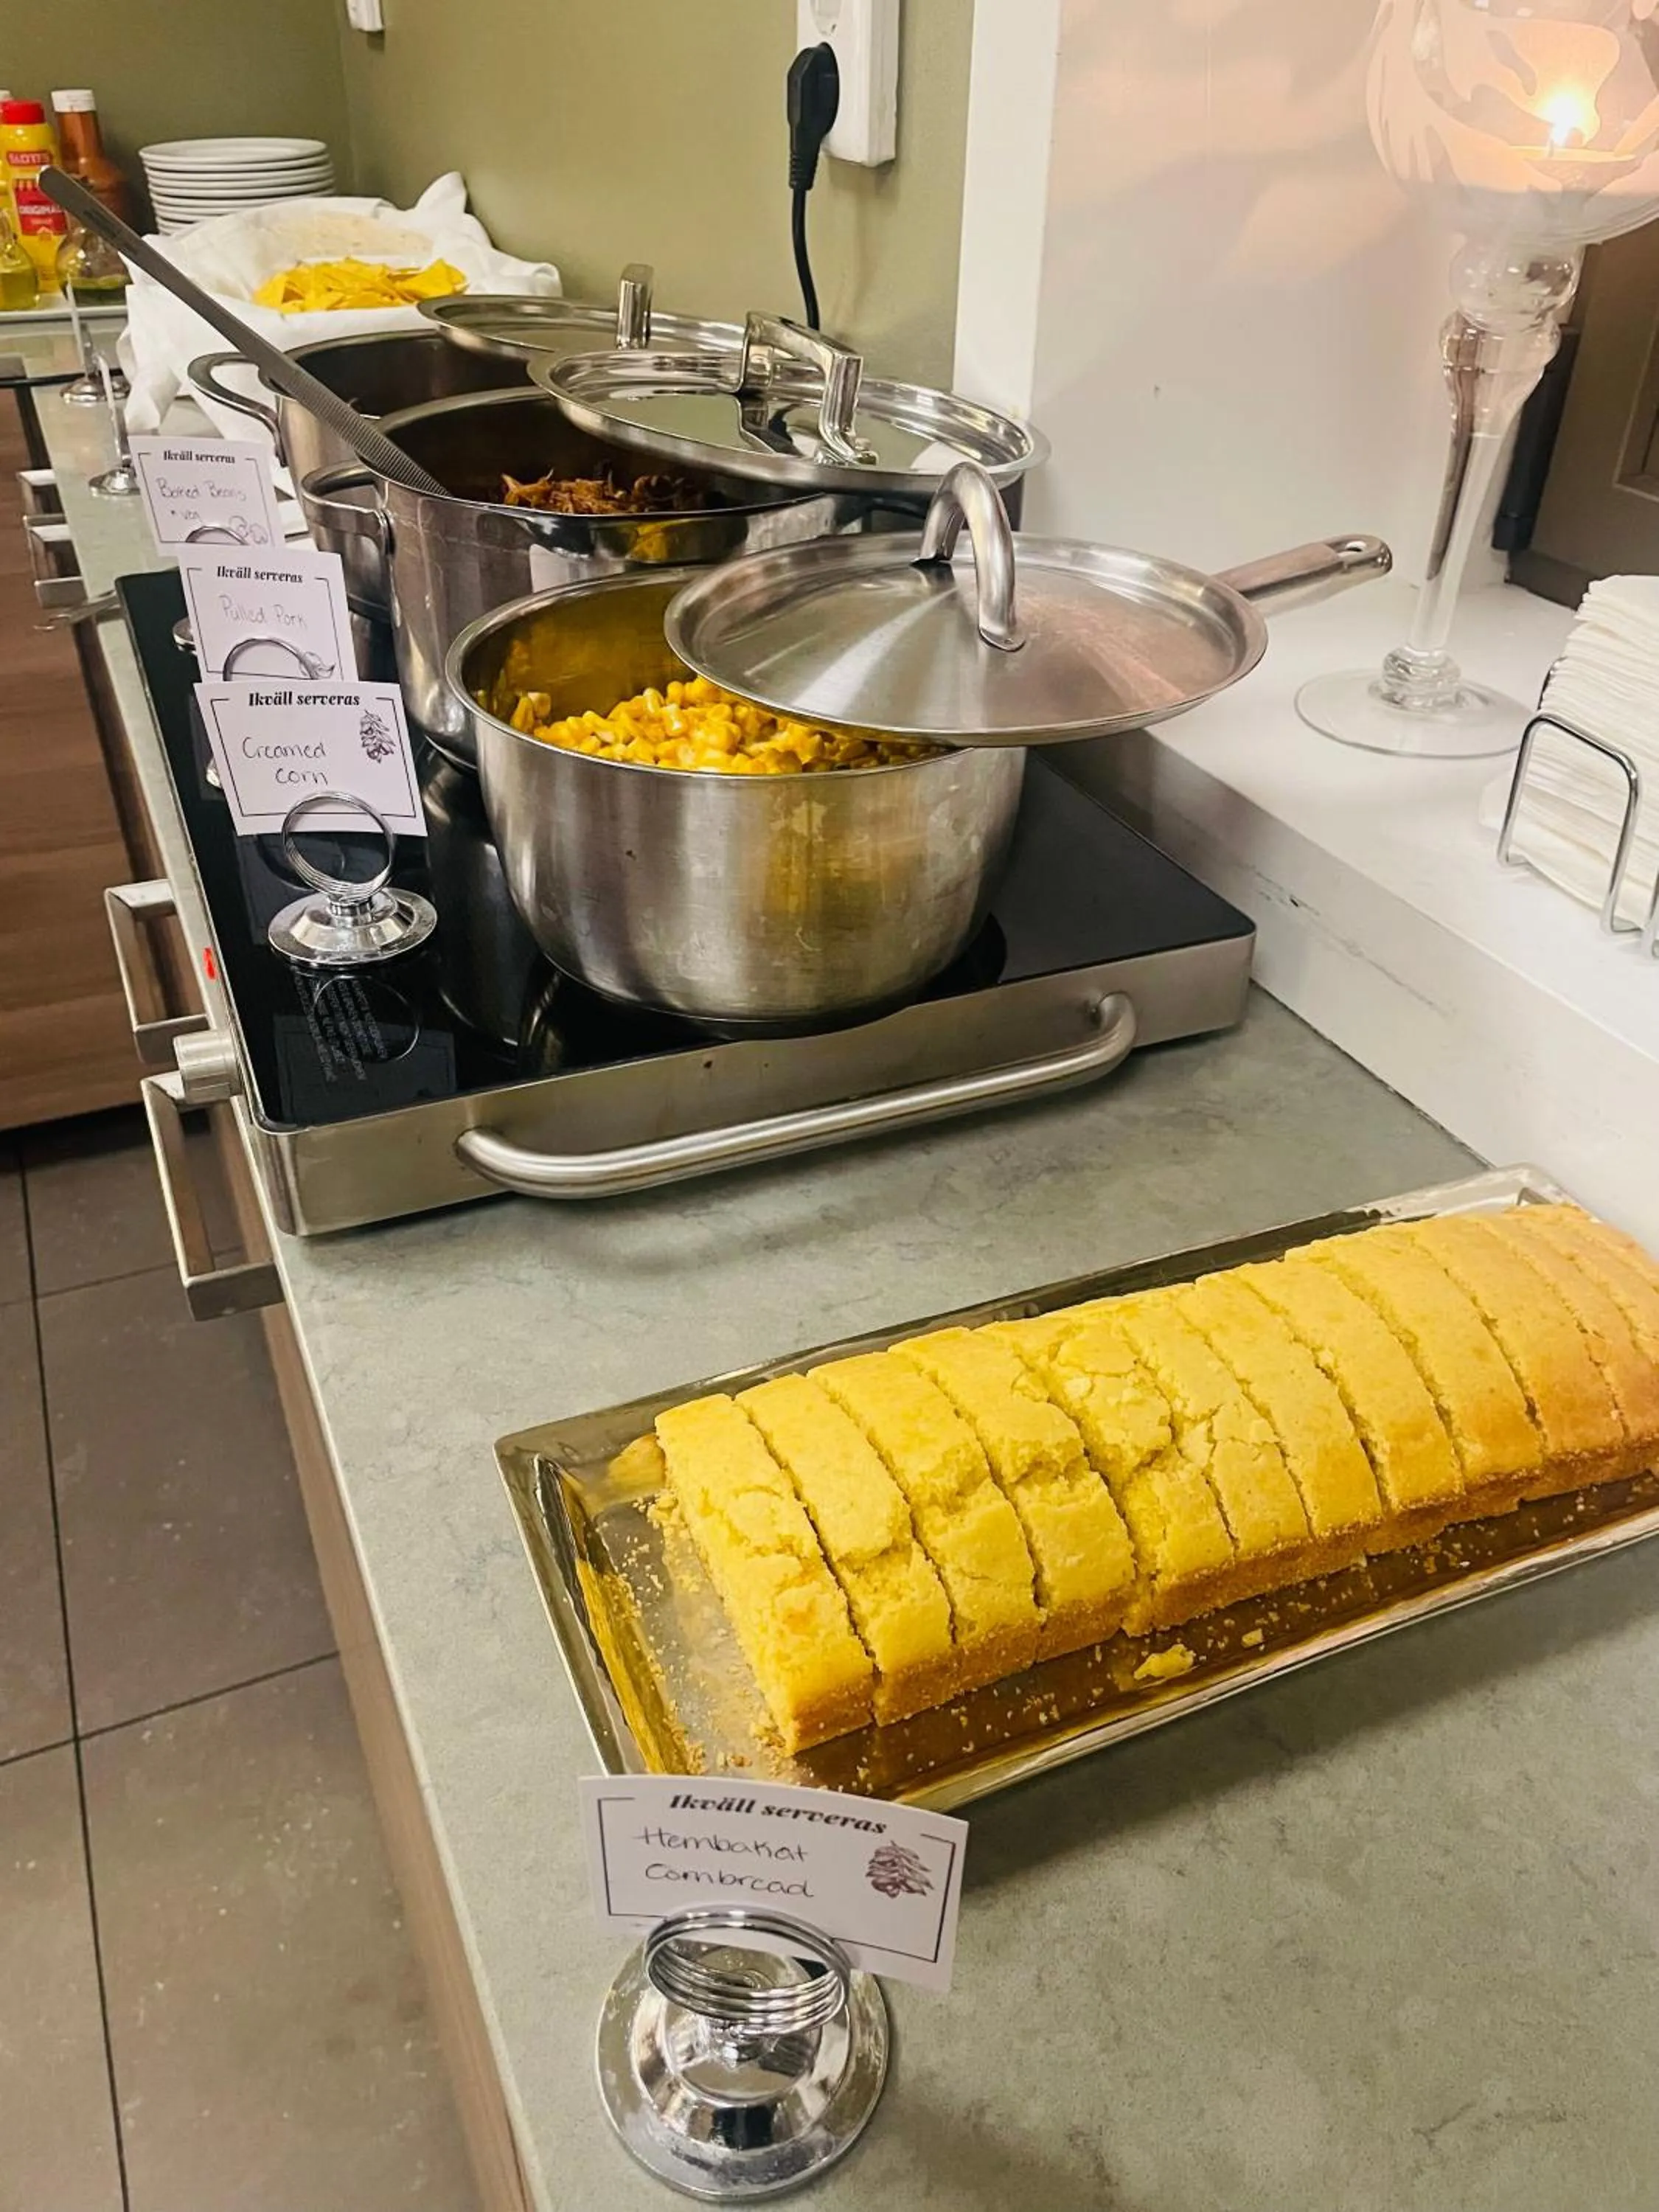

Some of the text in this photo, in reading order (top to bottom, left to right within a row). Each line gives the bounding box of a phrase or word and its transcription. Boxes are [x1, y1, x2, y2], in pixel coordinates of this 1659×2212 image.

[163, 450, 235, 464] Ikväll serveras
[217, 566, 303, 583] Ikväll serveras
[218, 594, 308, 630] Pulled Pork
[248, 691, 361, 707] Ikväll serveras
[242, 737, 327, 759] Creamed
[668, 1793, 888, 1834] Ikväll serveras
[632, 1826, 810, 1862] Hembakat
